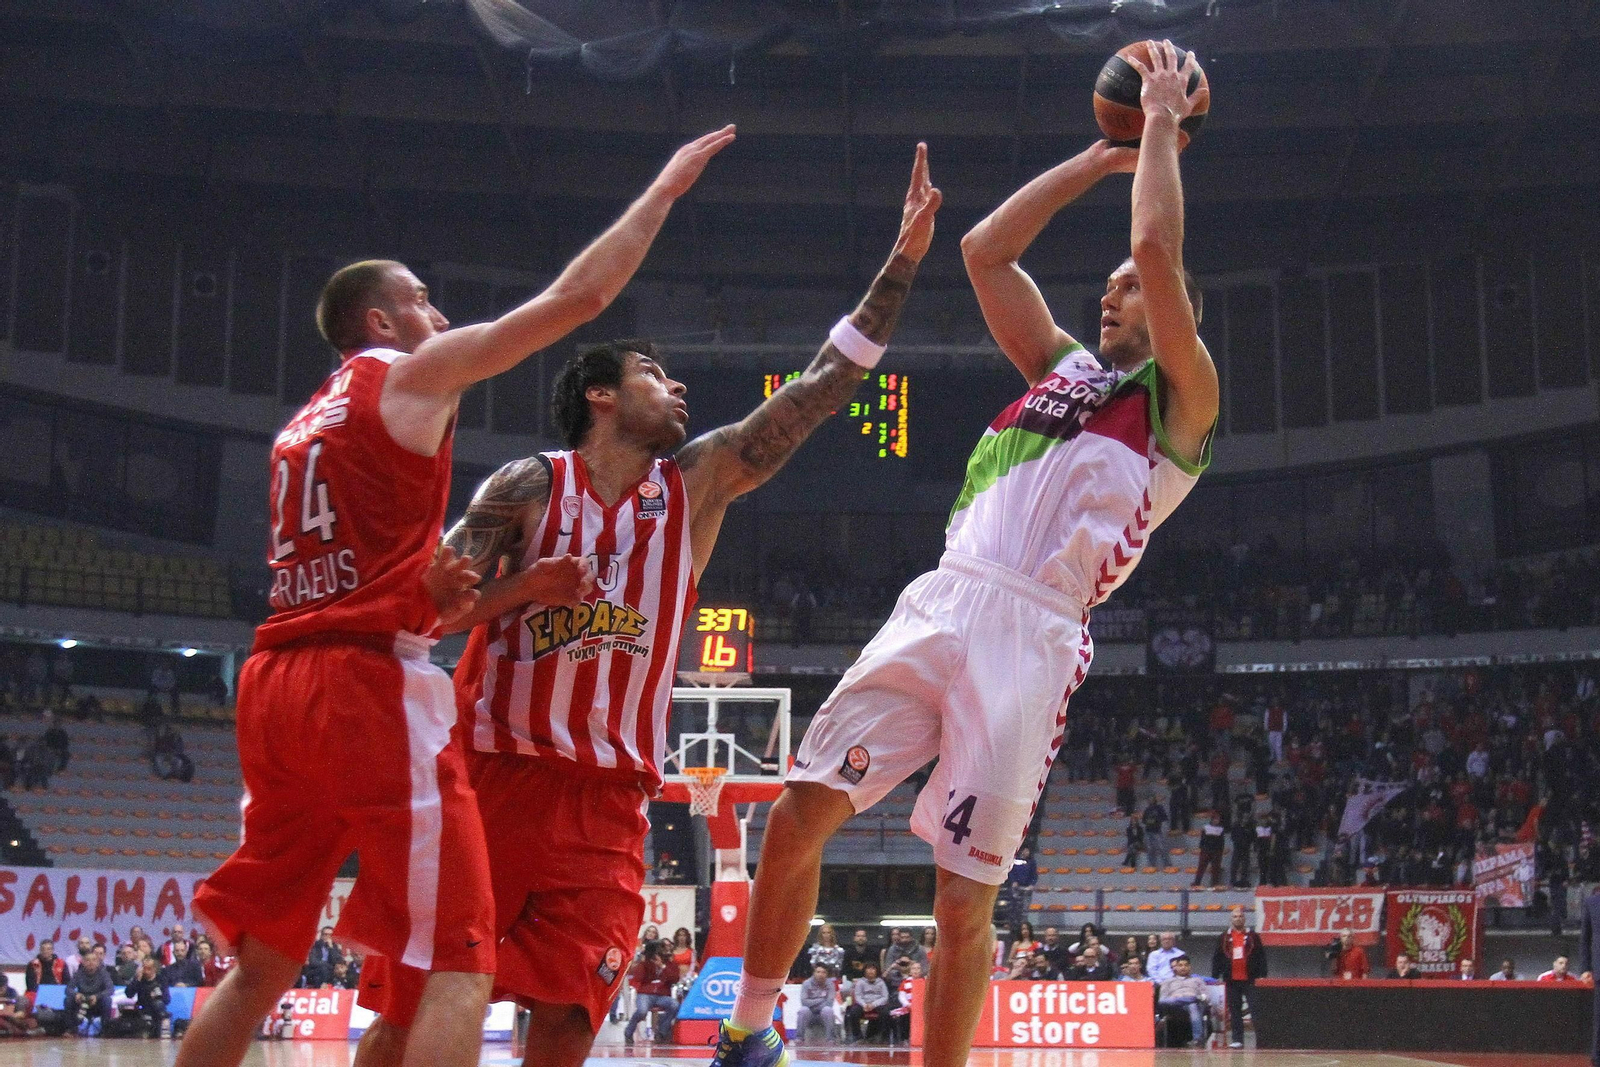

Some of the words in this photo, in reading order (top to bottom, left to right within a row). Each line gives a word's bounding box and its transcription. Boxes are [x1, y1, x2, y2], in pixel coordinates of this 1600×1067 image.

[1024, 394, 1069, 419] utxa
[273, 442, 337, 562] 24
[270, 548, 359, 606] RAEUS
[942, 790, 978, 845] 4
[0, 870, 205, 924] SALIMA
[1418, 950, 1447, 962] 1925
[1009, 984, 1128, 1015] official
[1011, 1016, 1100, 1044] store
